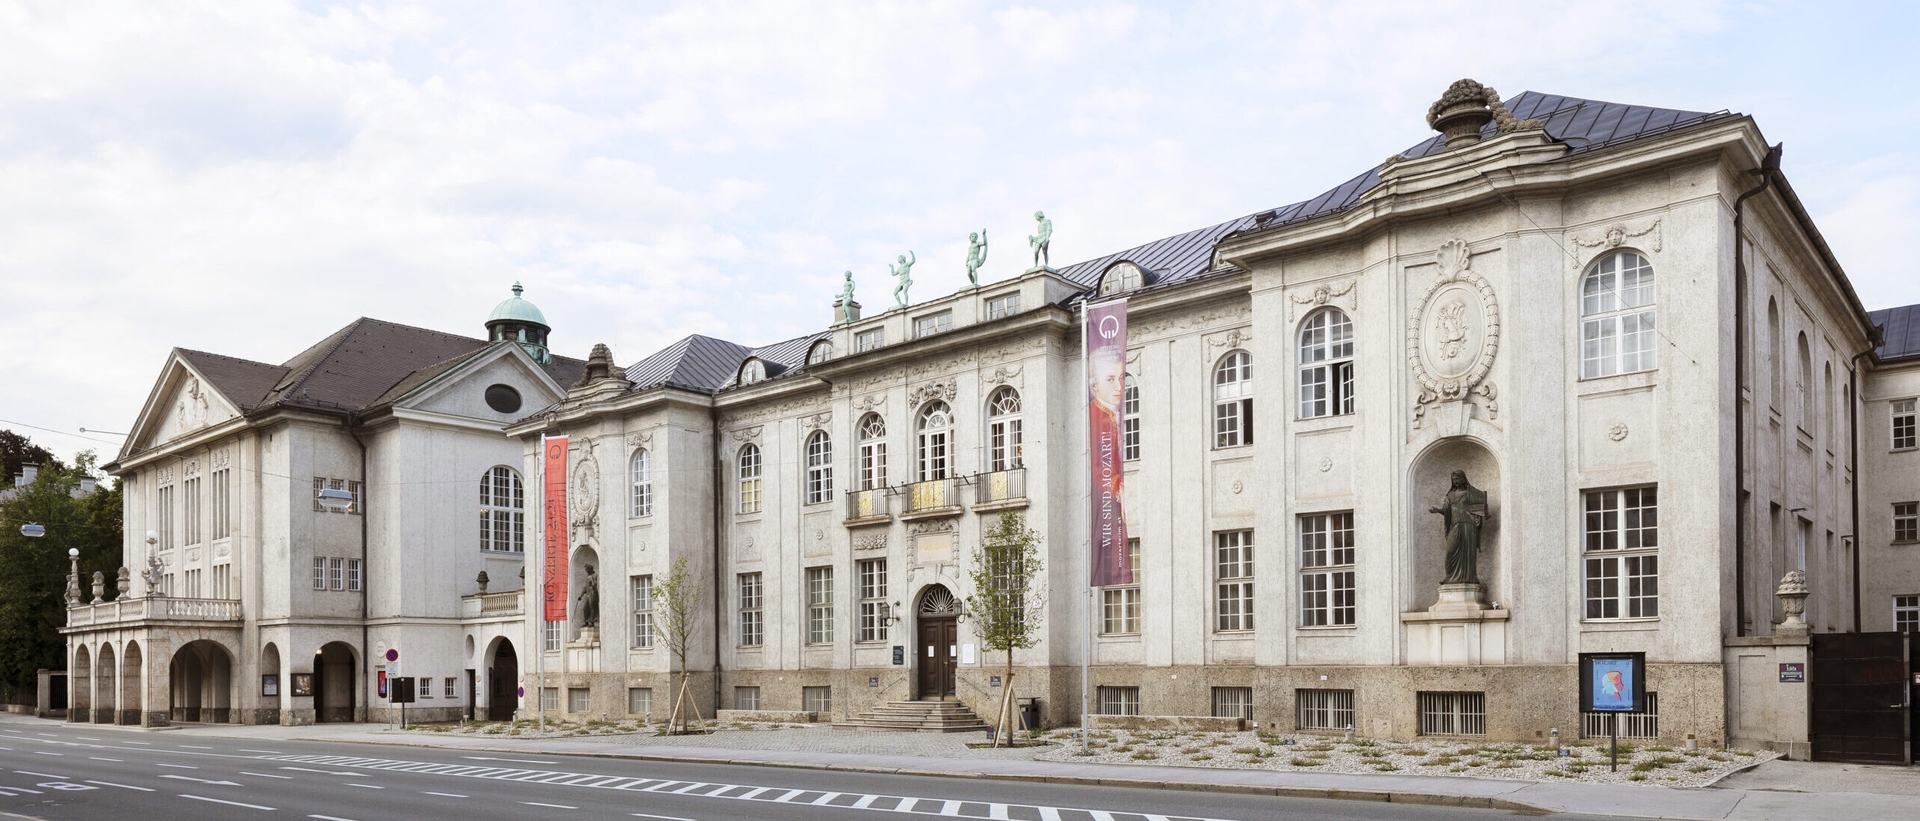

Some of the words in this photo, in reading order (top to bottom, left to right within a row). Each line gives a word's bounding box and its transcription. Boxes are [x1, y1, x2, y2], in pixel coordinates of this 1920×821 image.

[1101, 431, 1112, 487] MOZART!
[1102, 491, 1112, 520] SIND
[1102, 522, 1112, 547] WIR
[546, 535, 556, 602] KONZERTE
